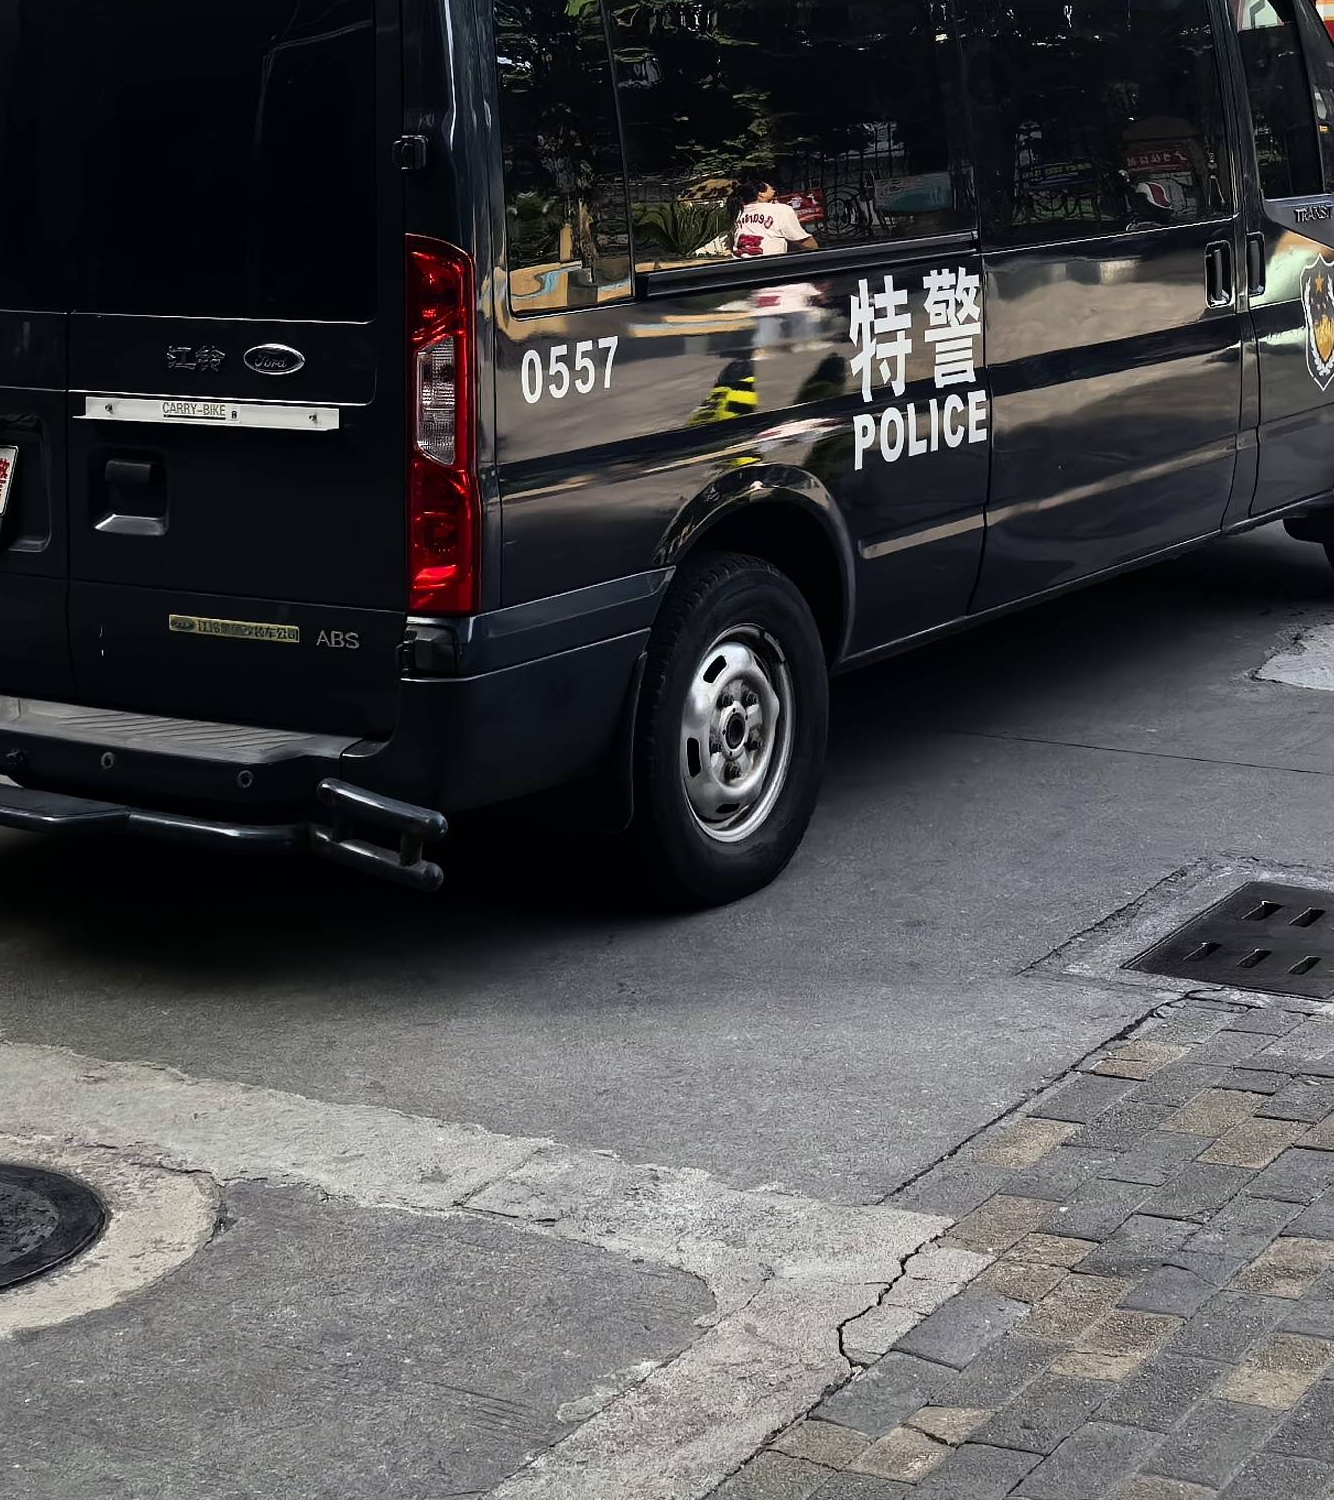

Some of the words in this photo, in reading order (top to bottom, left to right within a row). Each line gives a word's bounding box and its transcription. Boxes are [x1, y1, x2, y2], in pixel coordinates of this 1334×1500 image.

[849, 266, 982, 403] 特警
[521, 335, 619, 404] 0557
[162, 401, 227, 417] CARRY-BIKE
[853, 389, 988, 472] POLICE
[316, 630, 360, 649] ABS
